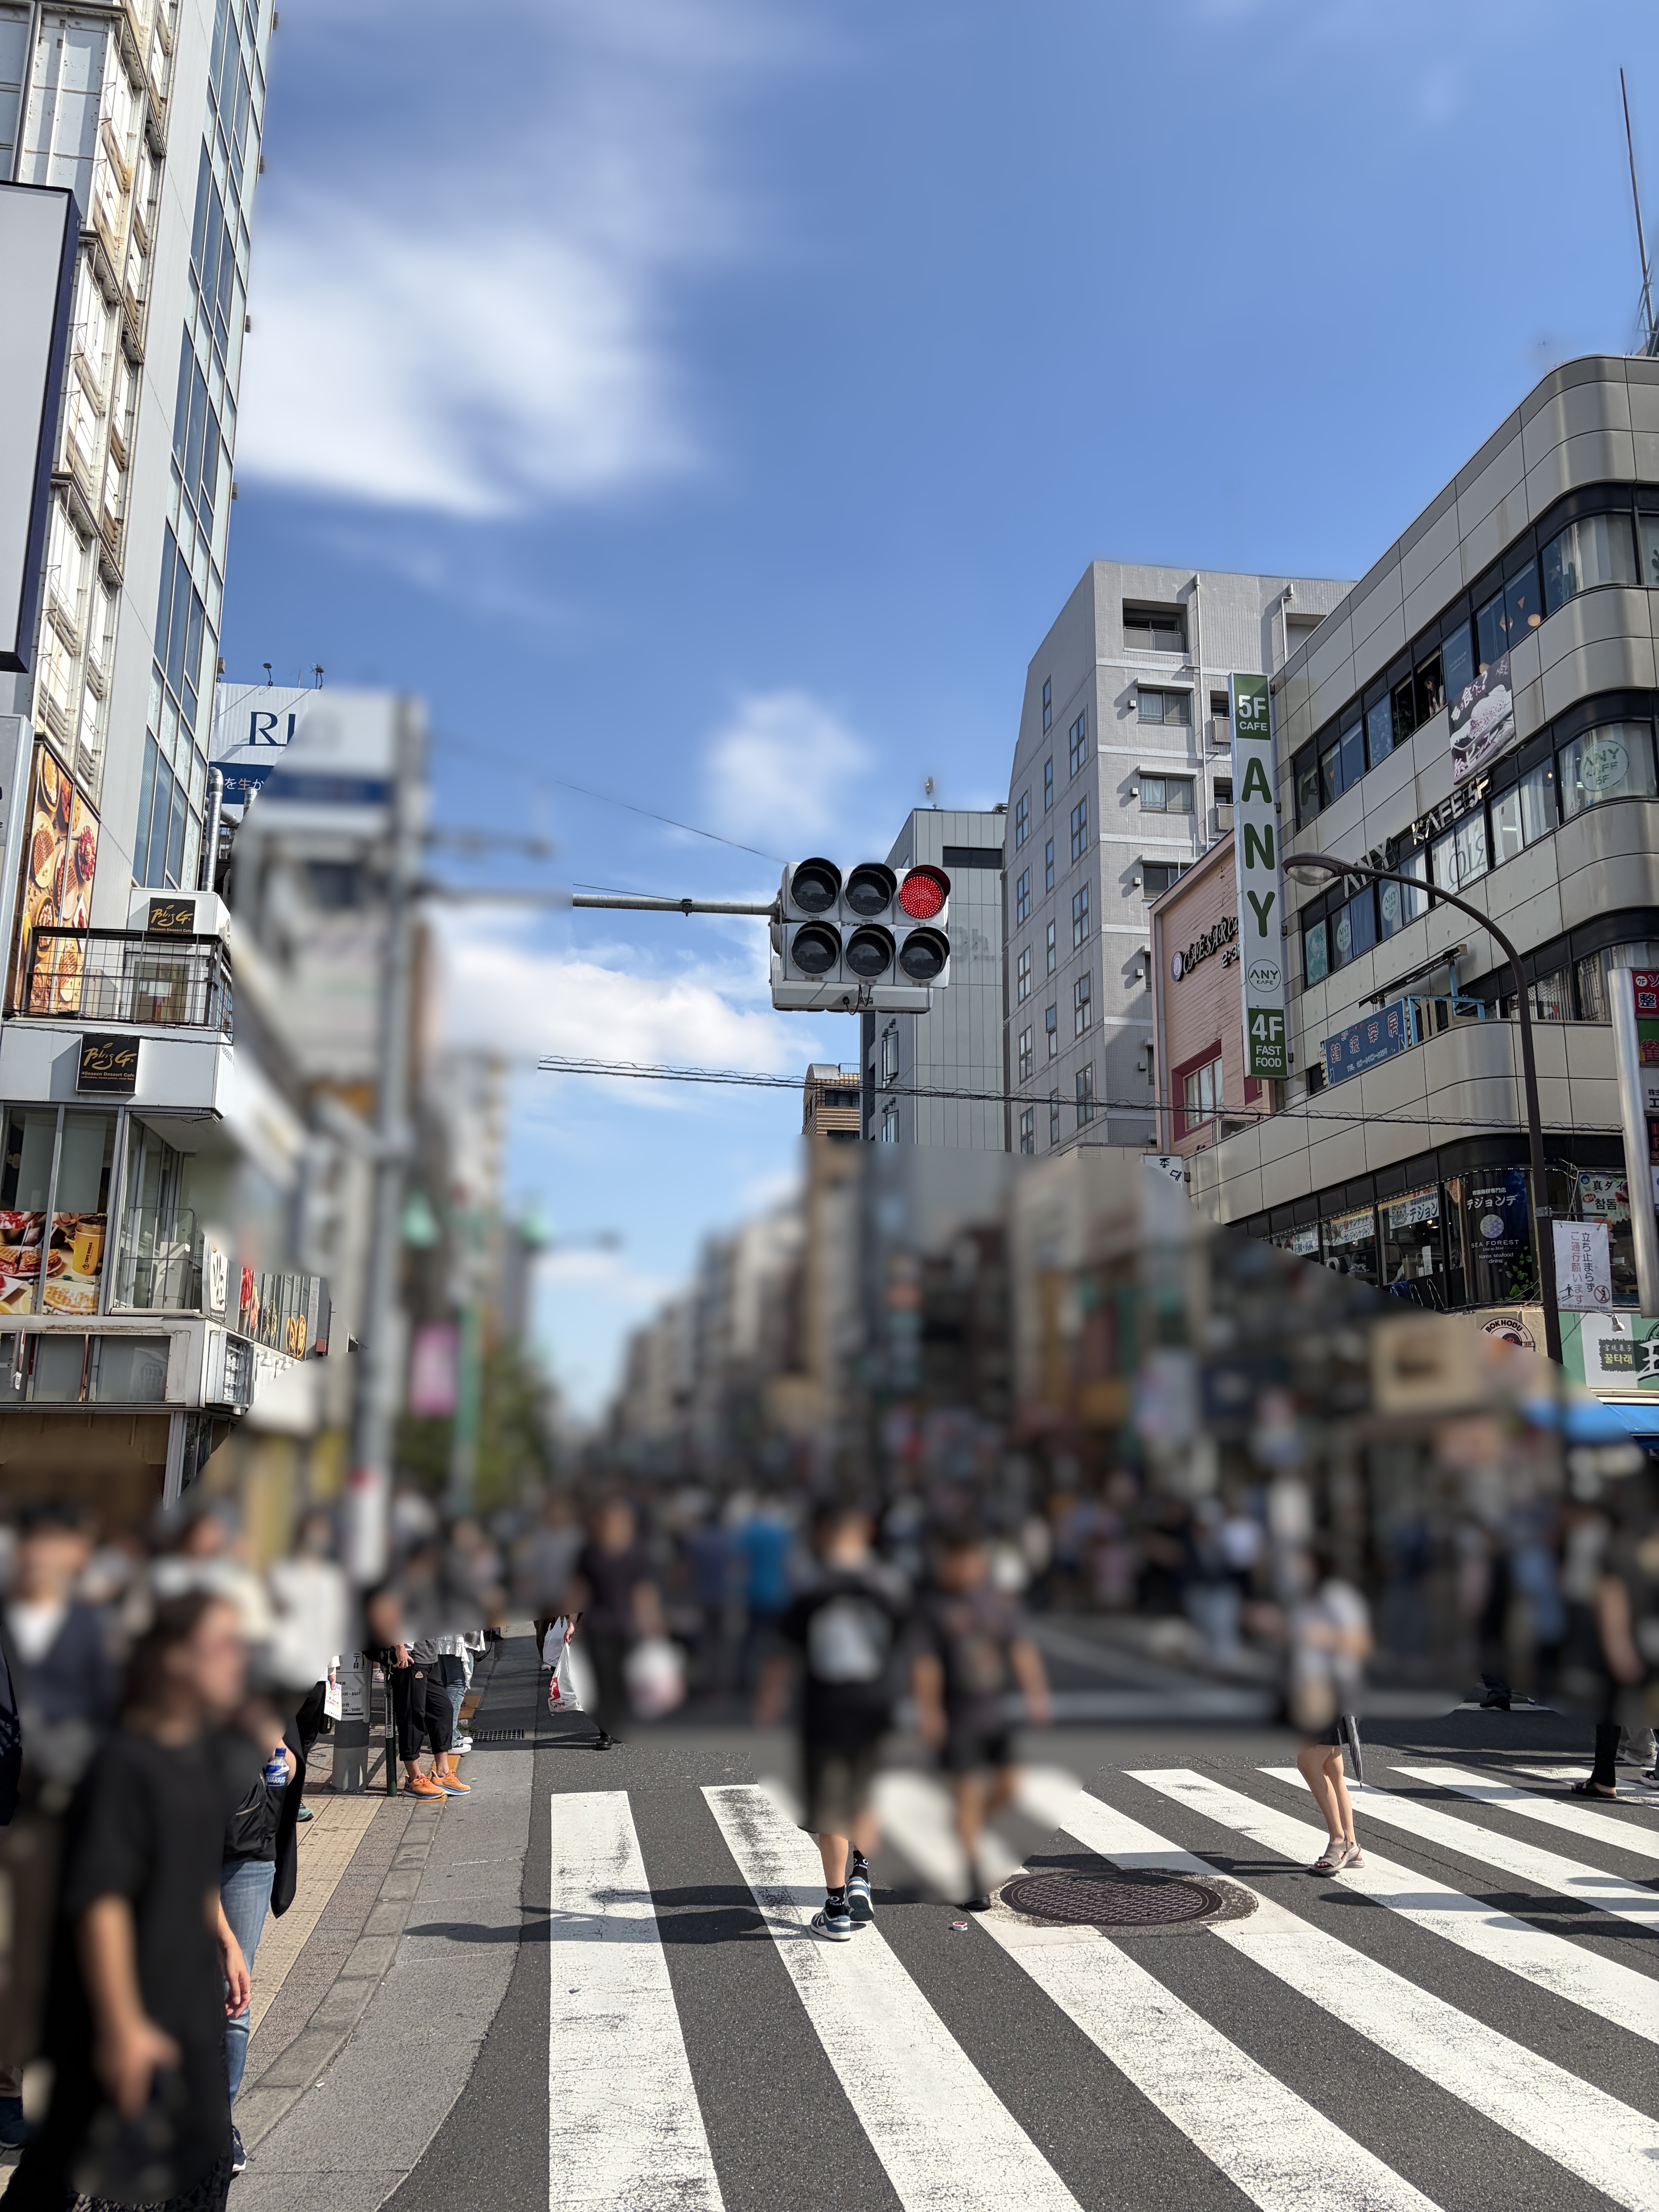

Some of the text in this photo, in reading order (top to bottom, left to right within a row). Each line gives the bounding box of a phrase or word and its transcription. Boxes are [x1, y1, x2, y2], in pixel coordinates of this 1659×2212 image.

[1238, 694, 1266, 719] 5F
[1239, 721, 1268, 731] CAFE
[1583, 747, 1620, 771] ANY
[1586, 761, 1618, 778] KAFE
[1411, 790, 1465, 846] KAFE
[1242, 757, 1275, 938] ANY
[1384, 891, 1396, 905] ANY
[1339, 924, 1350, 936] ANY
[1183, 917, 1238, 974] CAESAR Ca
[1250, 969, 1278, 979] ANY
[1251, 1014, 1283, 1041] 4F
[1330, 1011, 1398, 1063] 韓流茶房
[1256, 1045, 1282, 1056] FAST
[1255, 1057, 1281, 1067] FOOD
[1467, 1194, 1518, 1210] テジョンデ
[1595, 1198, 1618, 1210] 참돔
[1409, 1202, 1438, 1223] テジョン
[1571, 1231, 1584, 1304] ご通行願います
[1581, 1232, 1595, 1292] 立ち止まらず
[1604, 1354, 1633, 1364] 꿀타래
